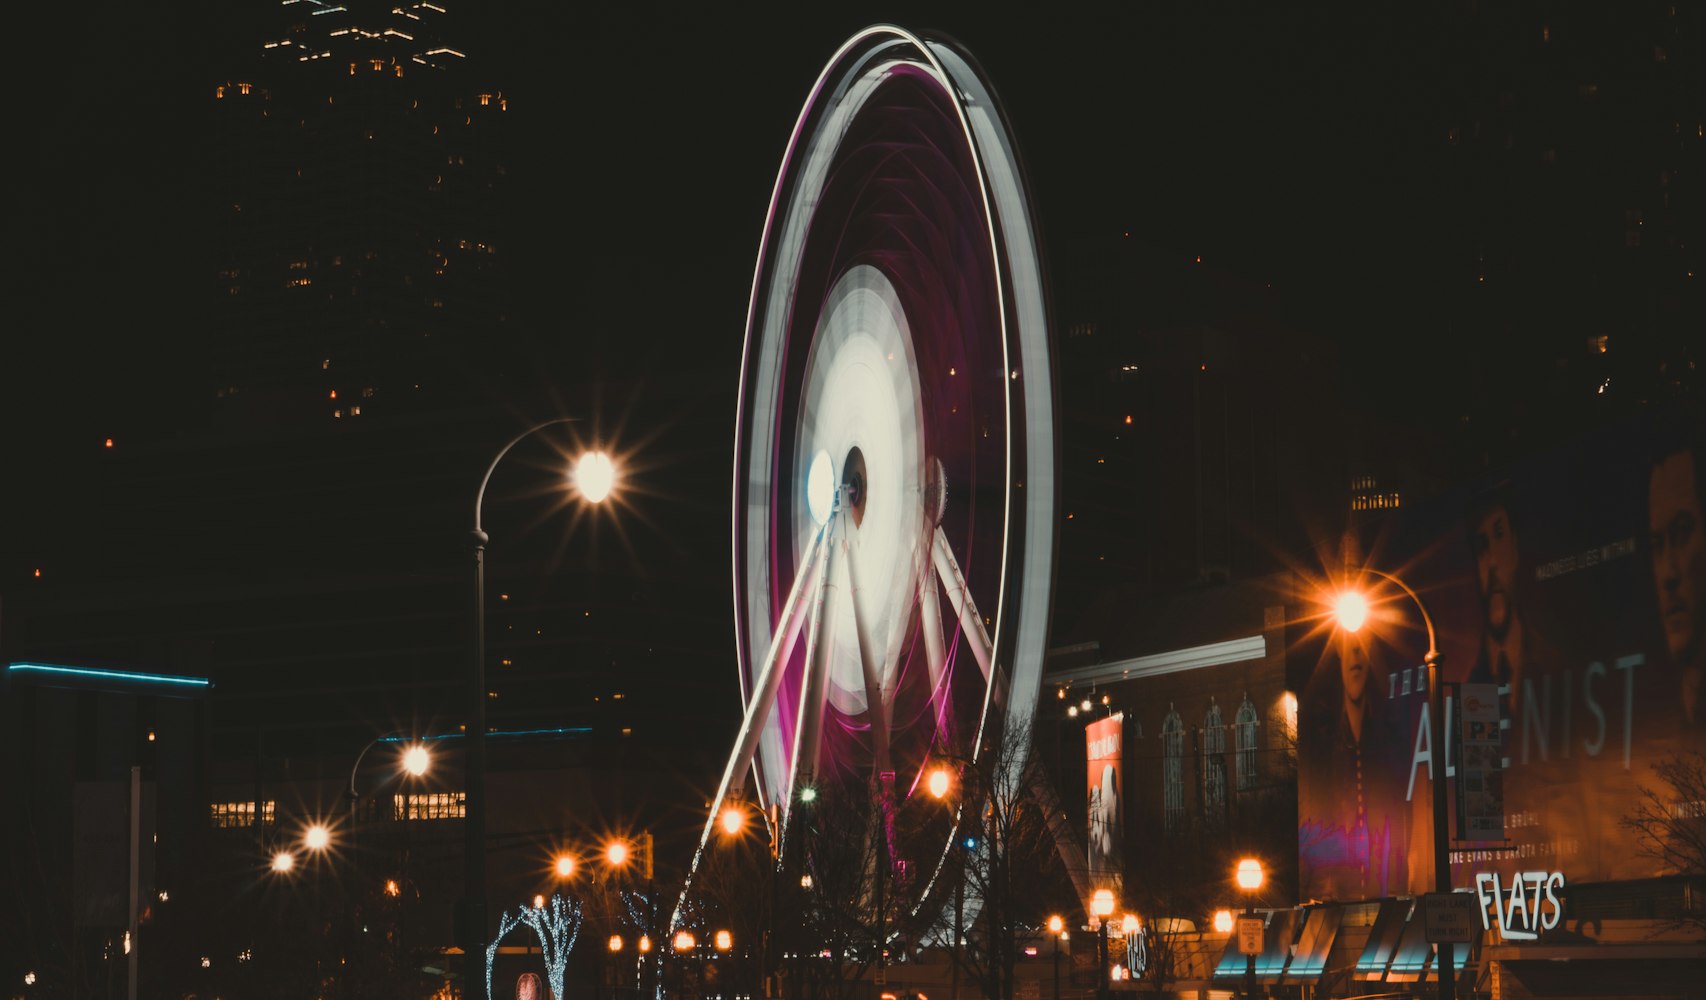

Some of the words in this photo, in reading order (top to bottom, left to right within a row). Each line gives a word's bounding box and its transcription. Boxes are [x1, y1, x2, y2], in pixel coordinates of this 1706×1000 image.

[1406, 652, 1646, 801] ALENIST
[1467, 850, 1492, 863] EVANS
[1475, 871, 1565, 940] FLATS
